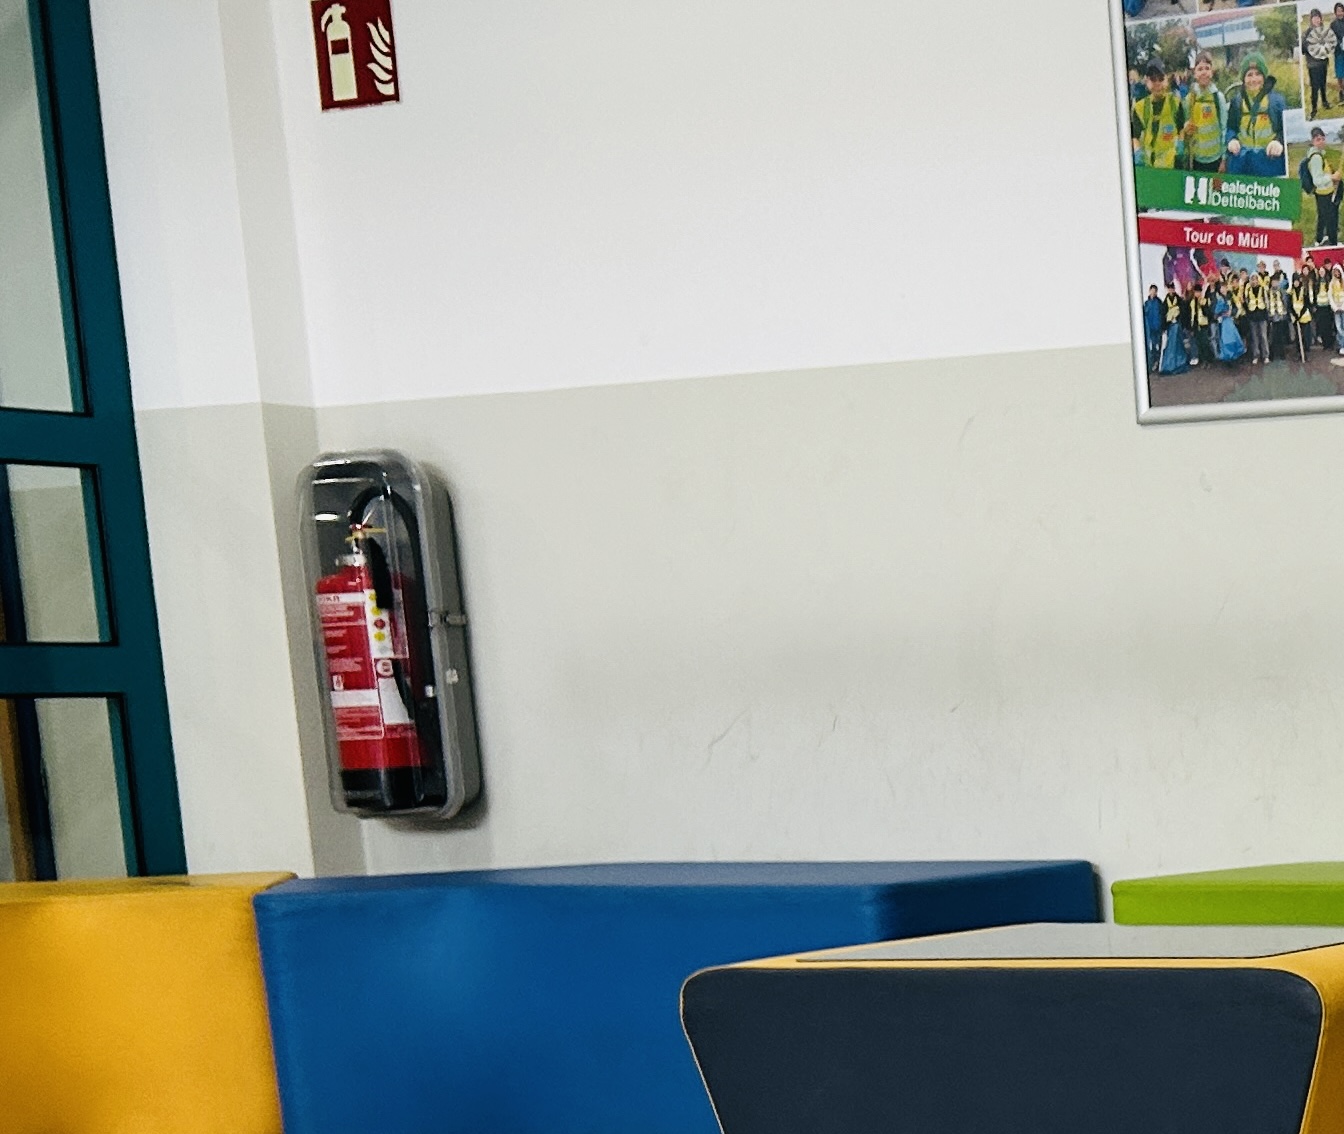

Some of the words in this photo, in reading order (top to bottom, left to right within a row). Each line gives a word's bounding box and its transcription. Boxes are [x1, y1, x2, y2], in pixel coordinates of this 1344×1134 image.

[1212, 192, 1280, 211] Dettelbach
[1183, 226, 1214, 244] Tour
[1216, 231, 1234, 246] de
[1238, 232, 1268, 249] Müll
